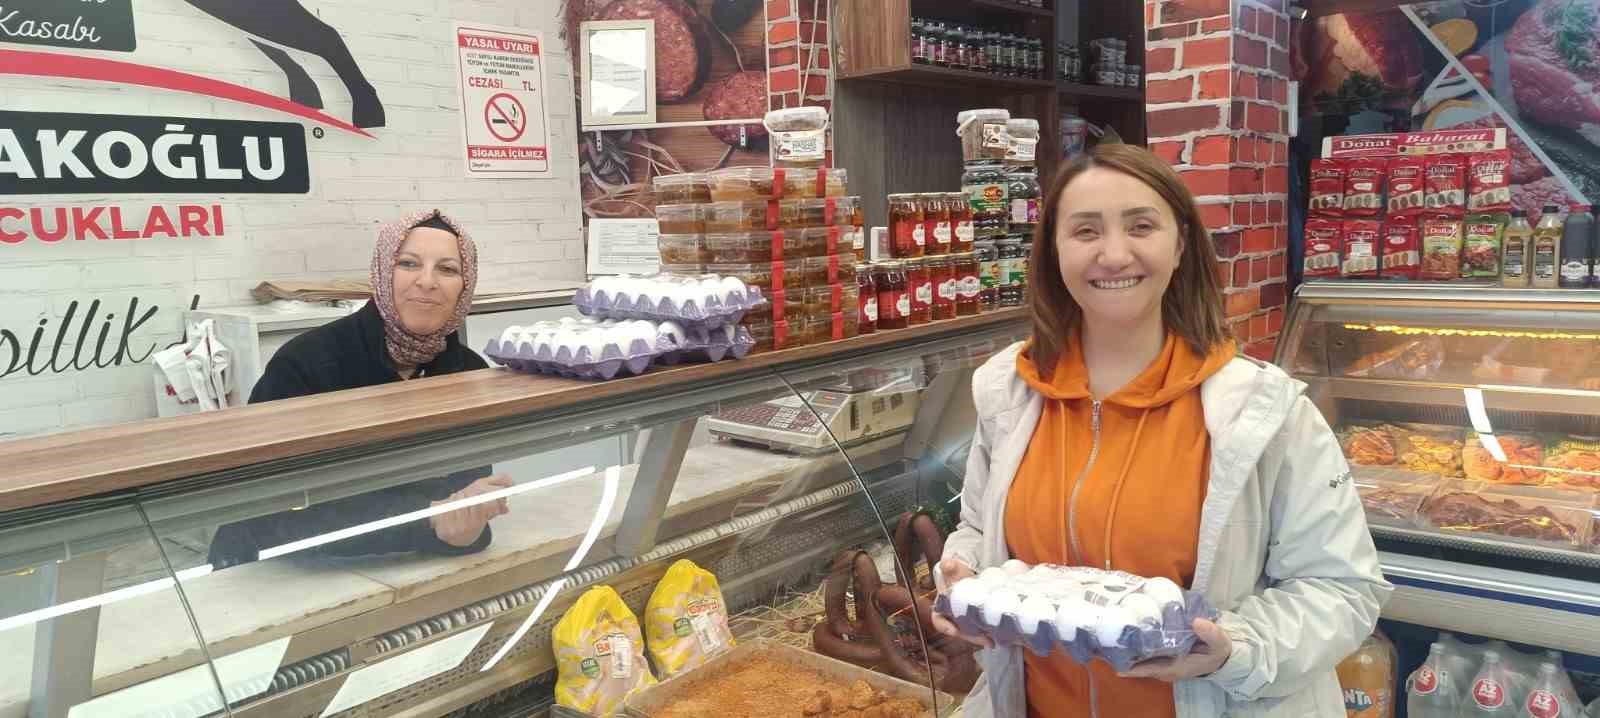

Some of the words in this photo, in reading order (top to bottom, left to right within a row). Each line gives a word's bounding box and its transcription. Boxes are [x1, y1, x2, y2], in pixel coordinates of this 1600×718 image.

[464, 36, 500, 49] YASAL
[502, 39, 534, 53] UYARI
[468, 76, 504, 89] CEZASI
[522, 80, 536, 92] TL.
[1340, 139, 1392, 149] Donat
[1405, 133, 1488, 143] Baharat
[471, 147, 508, 158] SİGARA
[508, 147, 545, 159] İÇİLMEZ
[0, 204, 225, 244] CUKLARI
